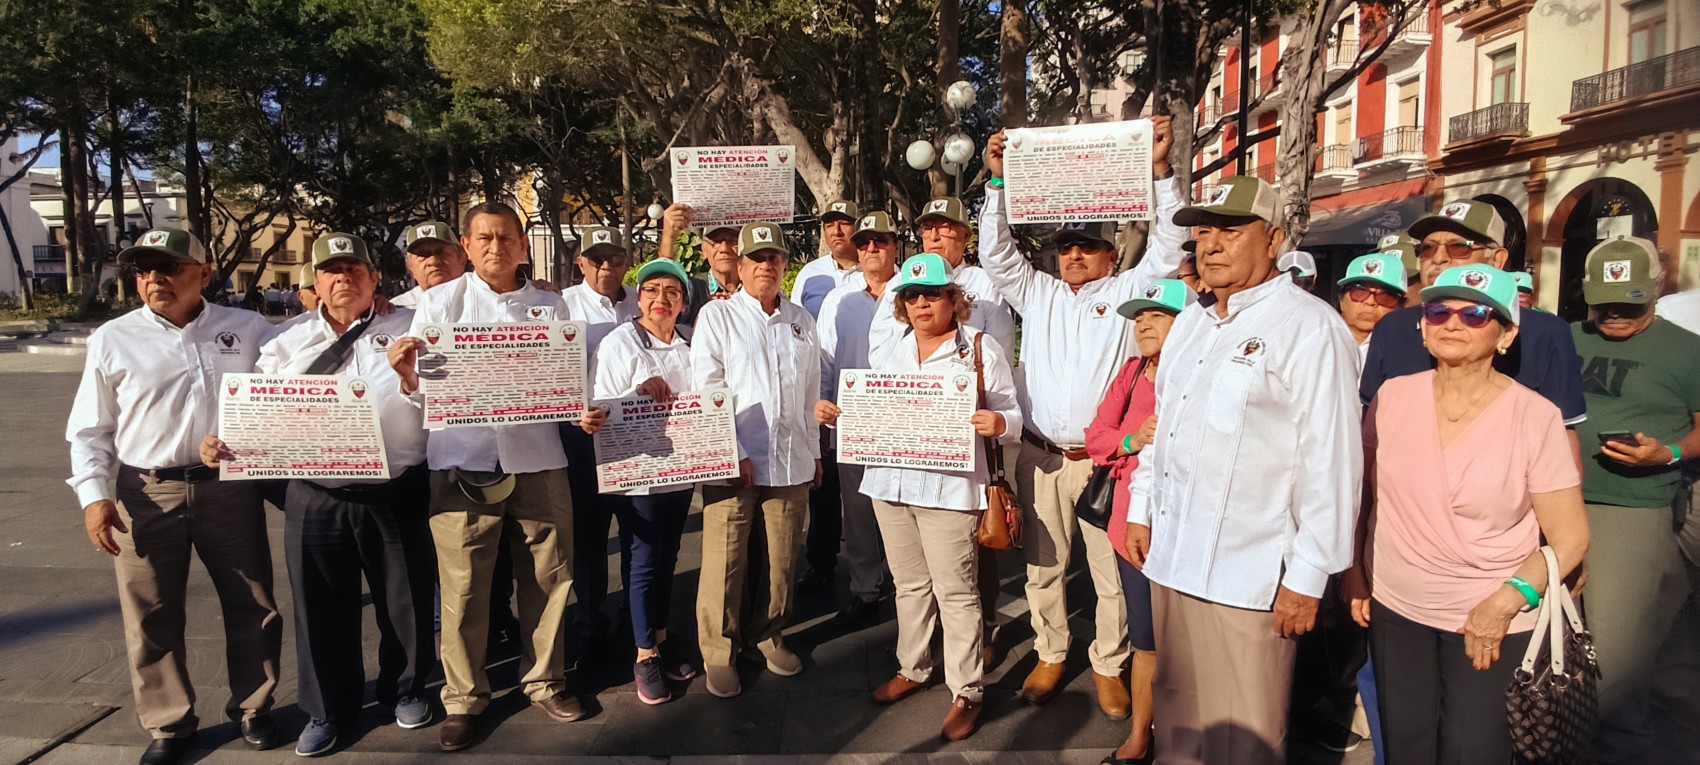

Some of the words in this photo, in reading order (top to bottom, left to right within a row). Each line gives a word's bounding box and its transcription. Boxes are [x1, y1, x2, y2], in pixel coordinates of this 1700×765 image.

[1046, 142, 1116, 151] ESPECIALIDADES
[1579, 355, 1640, 398] AT
[508, 412, 582, 422] LOGRAREMOS!
[636, 409, 703, 420] ESPECIALIDADES
[905, 459, 968, 468] LOGRAREMOS!
[671, 471, 734, 482] LOGRAREMOS!
